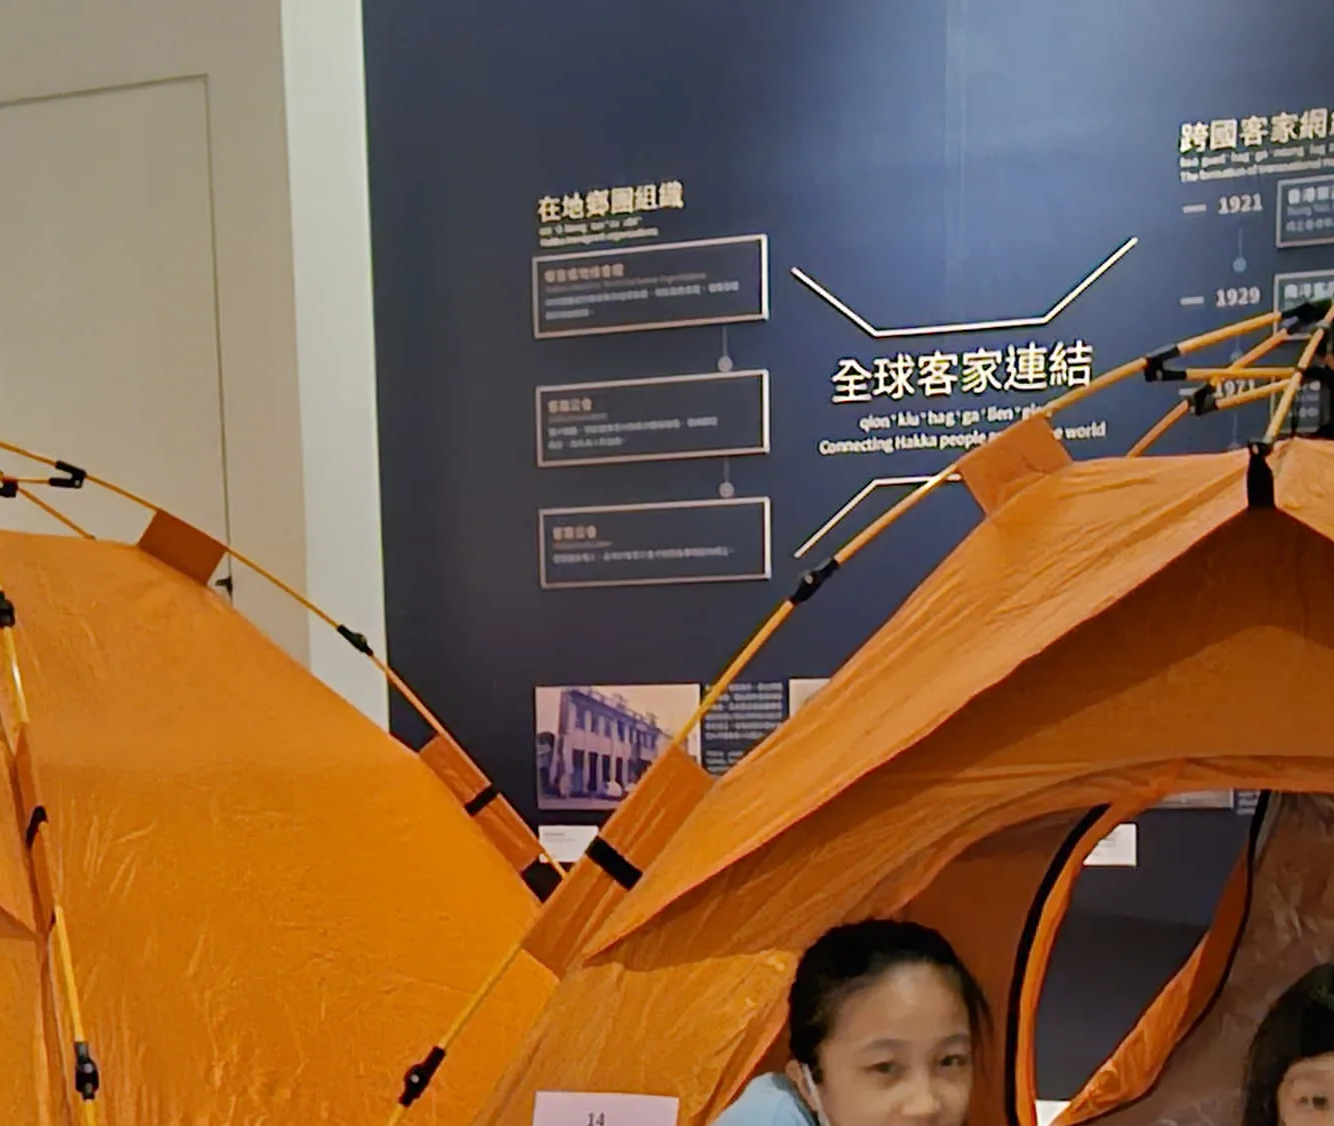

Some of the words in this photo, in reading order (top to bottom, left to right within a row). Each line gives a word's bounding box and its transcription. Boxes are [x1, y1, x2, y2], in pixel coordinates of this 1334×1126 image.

[1217, 192, 1264, 215] 1921
[1214, 285, 1261, 308] 1929
[830, 339, 1095, 404] 全球客家連結
[1064, 420, 1107, 440] world
[818, 435, 895, 456] Connecting
[894, 431, 939, 450] Hakka
[939, 428, 987, 450] people
